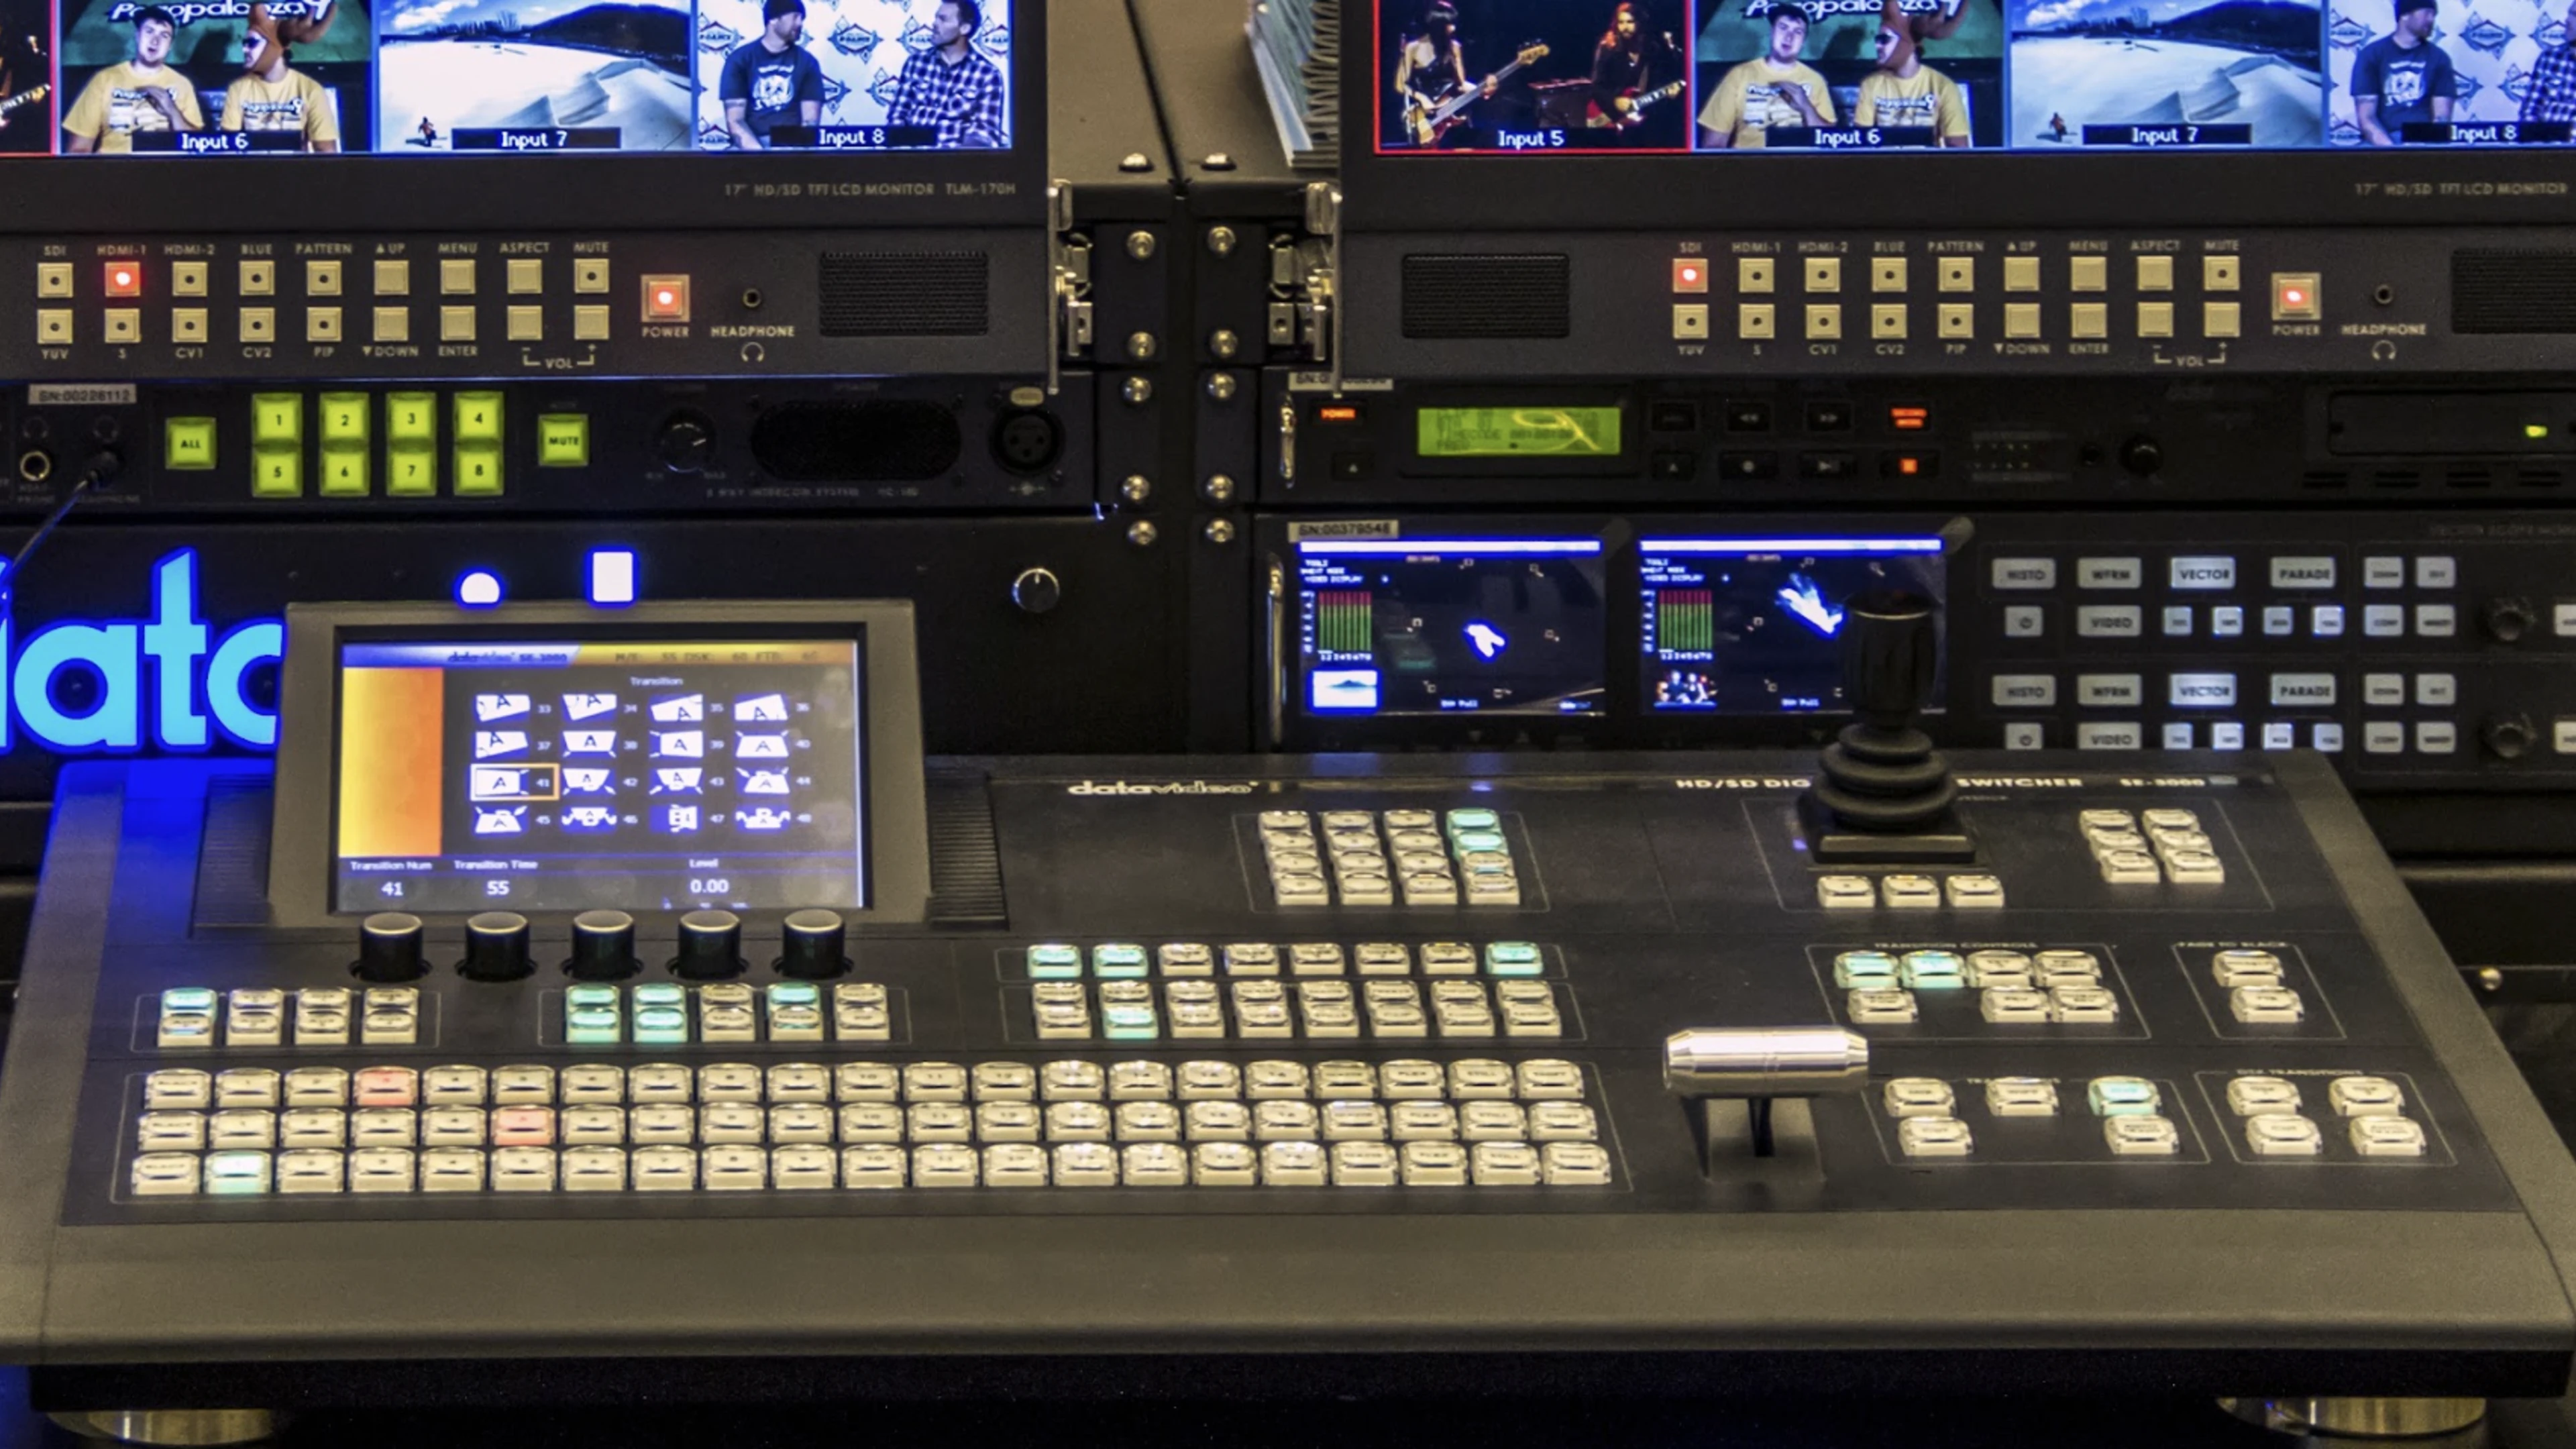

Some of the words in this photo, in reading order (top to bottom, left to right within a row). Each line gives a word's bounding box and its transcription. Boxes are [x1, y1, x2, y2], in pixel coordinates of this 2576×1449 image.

[820, 129, 865, 146] Input
[873, 129, 885, 144] 8
[1815, 129, 1860, 148] Input
[1868, 129, 1880, 144] 6
[2132, 128, 2180, 145] Input
[2186, 128, 2198, 143] 7
[2451, 125, 2497, 142] Input
[2504, 125, 2517, 140] 8
[182, 134, 228, 152] Input
[235, 134, 249, 149] 6
[501, 132, 551, 150] Input
[556, 132, 568, 147] 7
[1499, 131, 1546, 149] Input
[1551, 131, 1564, 146] 5
[755, 184, 801, 196] HD/SD
[808, 184, 830, 196] TFT
[833, 184, 861, 196] LCD
[865, 183, 934, 195] MONITOR
[2440, 183, 2463, 195] TFT
[2465, 183, 2493, 195] LCD
[2497, 182, 2567, 195] MONITOR
[44, 246, 66, 256] SDI
[97, 245, 146, 256] HDMI-1
[164, 244, 214, 255] HDMI-2
[241, 244, 271, 254] BLUE
[296, 244, 352, 254] PATTERN
[388, 243, 405, 254] UP
[439, 243, 477, 253] MENU
[500, 242, 549, 253] ASPECT
[574, 241, 608, 253] MUTE
[1680, 242, 1701, 253] SDI
[1732, 242, 1780, 252] HDMI-1
[1799, 241, 1847, 252] HDMI-2
[1874, 241, 1904, 252] BLUE
[1928, 241, 1984, 251] PATTERN
[2020, 241, 2036, 252] UP
[2070, 241, 2107, 251] MENU
[2131, 240, 2180, 251] ASPECT
[2204, 240, 2239, 251] MUTE
[643, 327, 690, 337] POWER
[711, 326, 795, 337] HEADPHONE
[2273, 325, 2320, 335] POWER
[2341, 324, 2426, 335] HEADPHONE
[119, 348, 126, 359] S
[176, 347, 203, 358] CV1
[243, 347, 271, 358] CV2
[314, 347, 333, 356] PIP
[374, 346, 419, 356] DOWN
[439, 346, 477, 356] ENTER
[1678, 345, 1704, 355] YUV
[1809, 344, 1836, 355] CV1
[1876, 344, 1904, 355] CV2
[1947, 344, 1966, 354] PIP
[2006, 343, 2049, 354] DOWN
[2070, 343, 2108, 354] ENTER
[42, 350, 68, 360] YUV
[545, 358, 573, 369] VOL
[2177, 356, 2204, 367] VOL
[276, 415, 281, 425] 1
[341, 415, 349, 425] 2
[408, 414, 415, 425] 3
[475, 413, 483, 424] 4
[180, 440, 201, 449] ALL
[549, 437, 579, 446] MUTE
[274, 466, 282, 478] 5
[341, 466, 348, 477] 6
[408, 466, 415, 476] 7
[475, 465, 483, 476] 8
[2006, 570, 2045, 580] HISTO
[2180, 570, 2230, 580] VECTOR
[2280, 570, 2330, 580] PARADE
[2092, 617, 2131, 627] VIDEO
[630, 676, 684, 686] Transition
[2180, 686, 2230, 697] VECTOR
[2280, 686, 2330, 697] PARADE
[624, 704, 637, 712] 34
[710, 704, 724, 712] 35
[2090, 735, 2131, 745] VIDEO
[538, 742, 551, 750] 37
[1067, 780, 1252, 794] datavideo
[1676, 779, 1758, 788] HD/SD
[1956, 778, 2082, 788] SWITCHER
[351, 861, 403, 870] Transition
[407, 862, 431, 870] Num
[455, 861, 507, 869] Transition
[511, 861, 538, 869] Time
[690, 859, 718, 868] Level
[382, 883, 403, 896] 41
[487, 881, 509, 895] 55
[690, 880, 729, 893] 0.00
